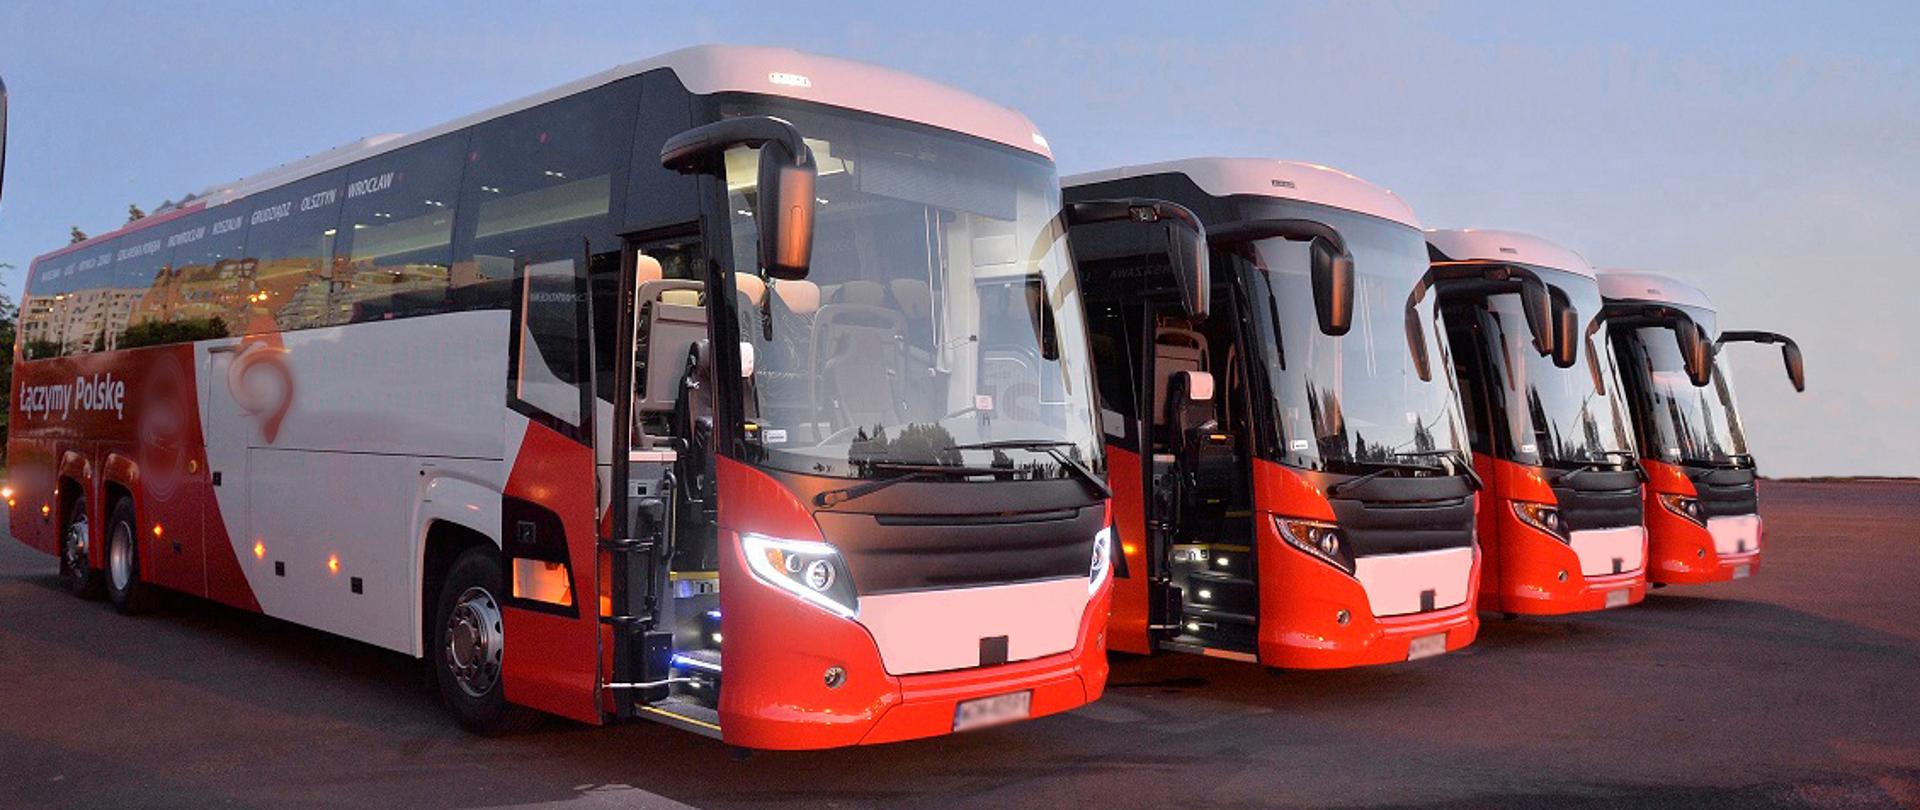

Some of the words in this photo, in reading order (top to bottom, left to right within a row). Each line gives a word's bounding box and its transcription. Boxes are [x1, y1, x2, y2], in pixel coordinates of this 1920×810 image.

[251, 202, 291, 225] GRUDZIĄDZ
[301, 188, 338, 211] OLSZTYN
[348, 172, 394, 199] WROCŁAW
[19, 381, 73, 420] Łączymy
[74, 373, 125, 420] Polskę
